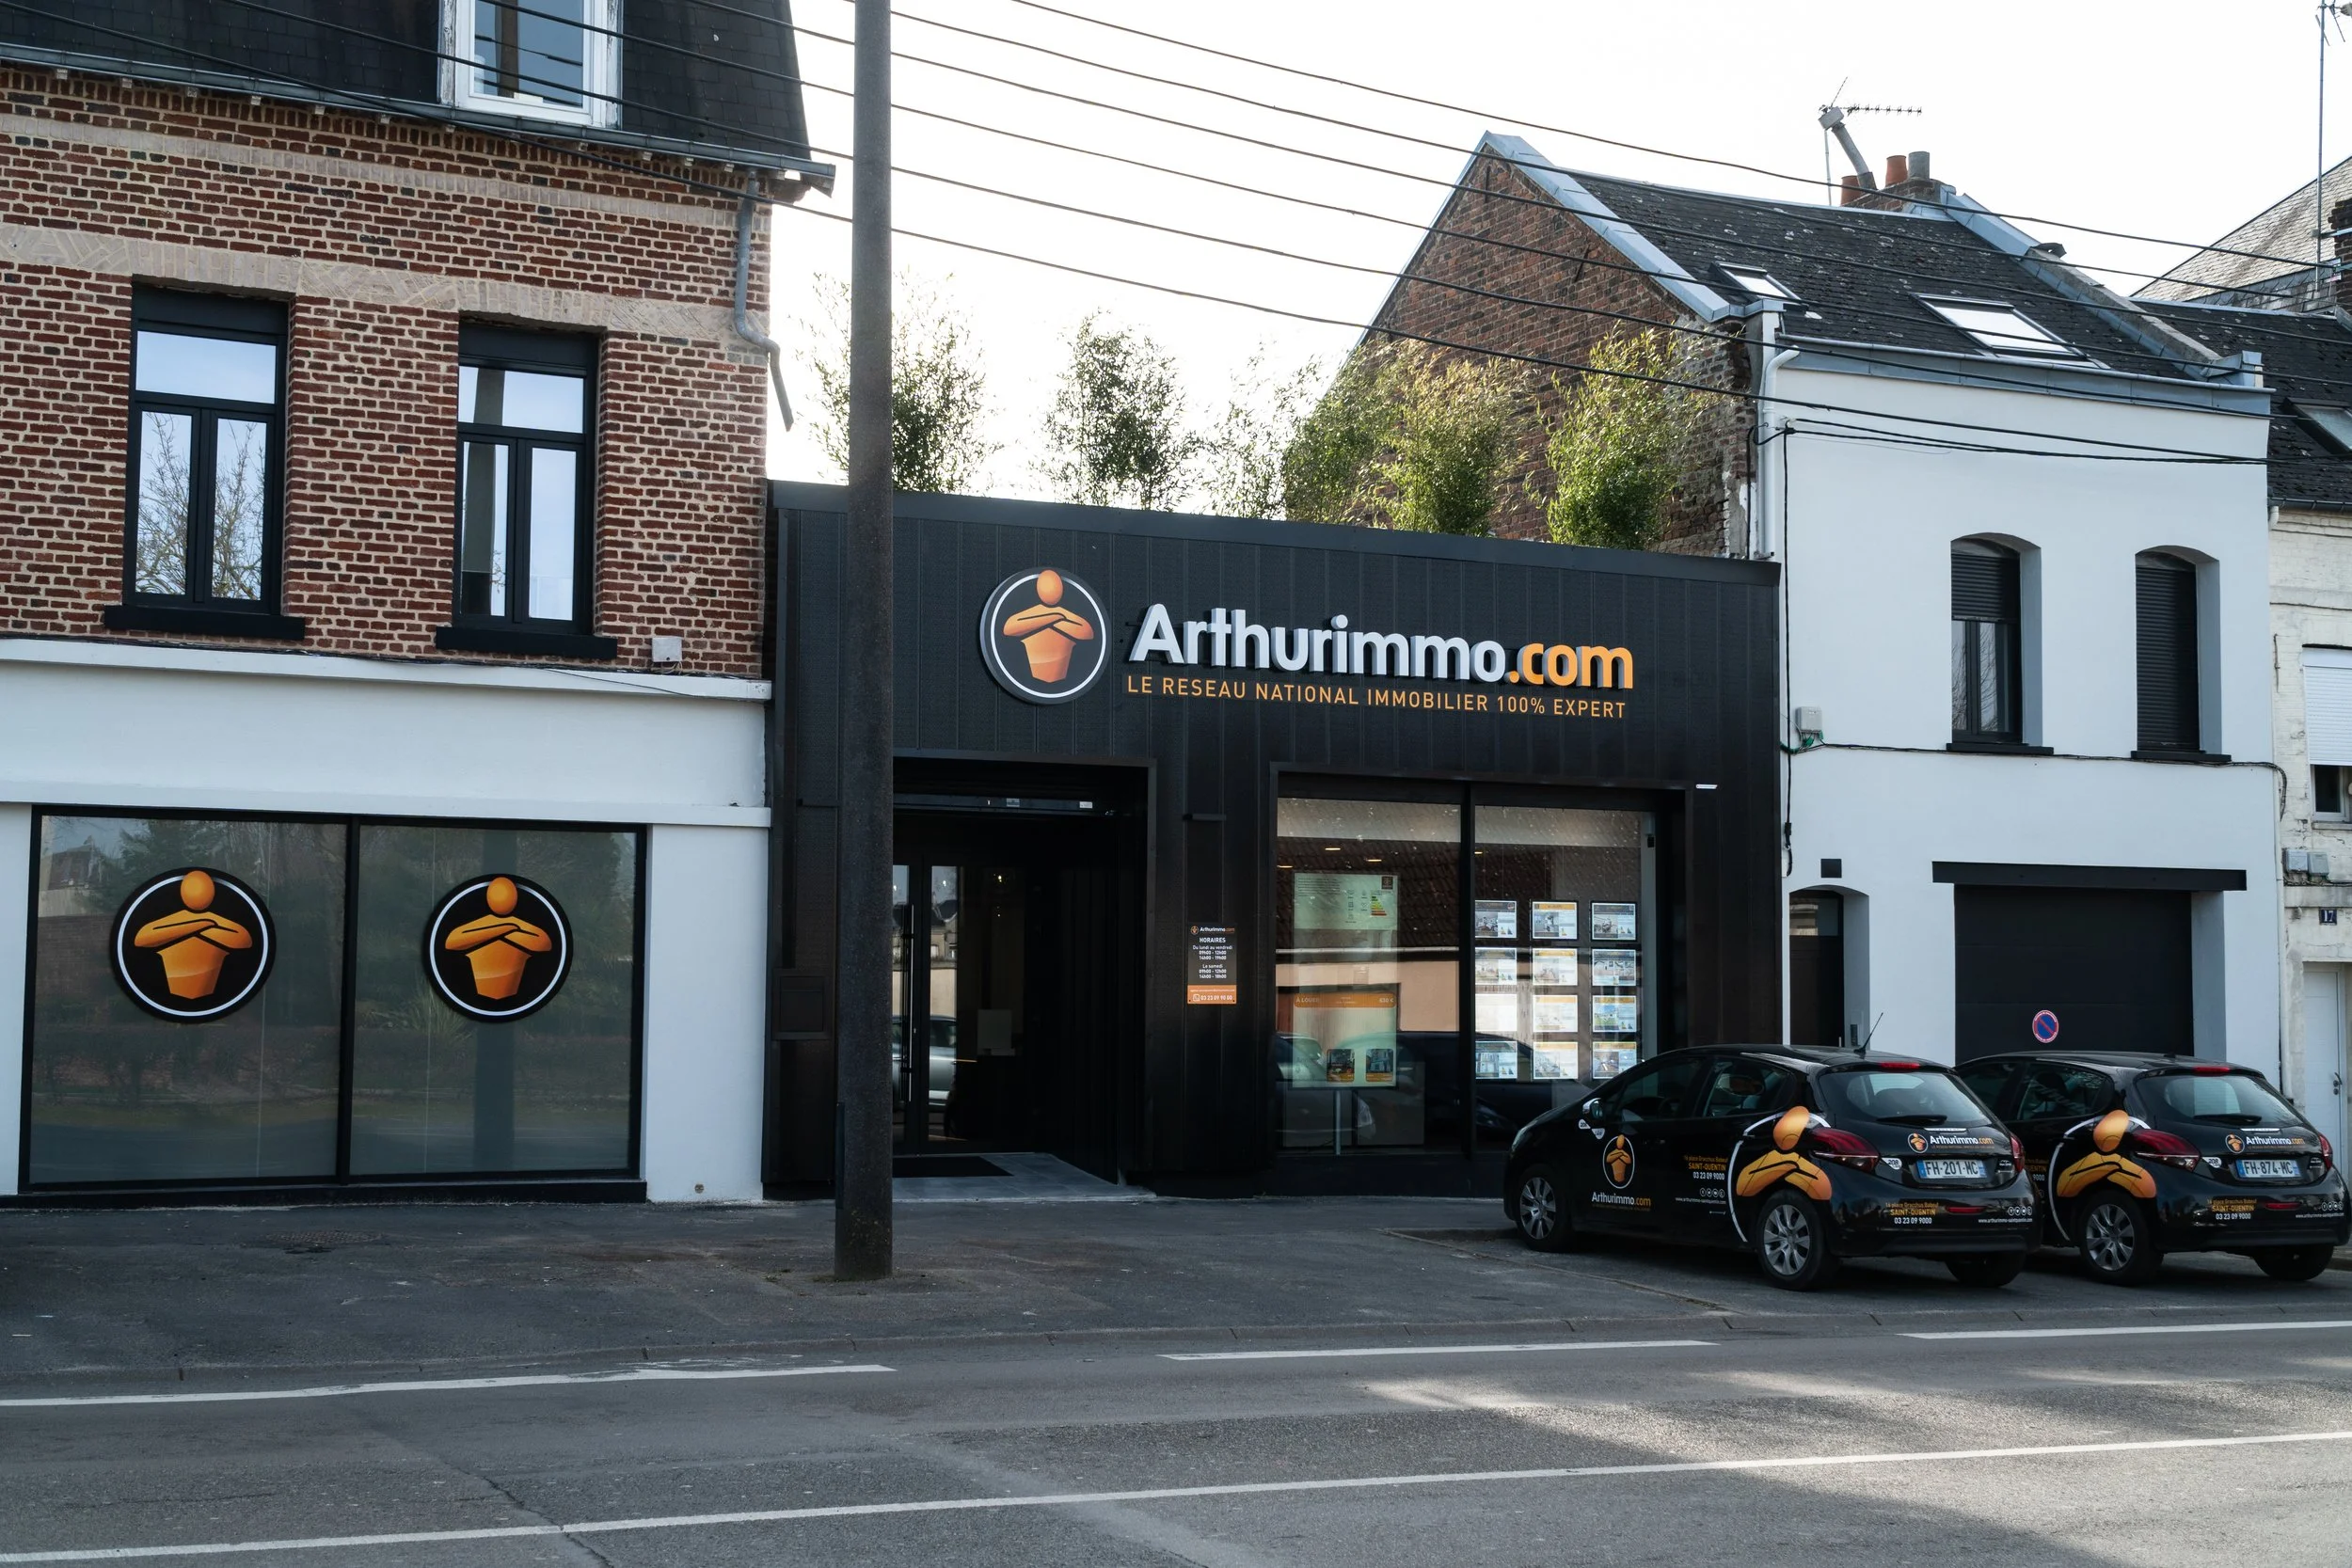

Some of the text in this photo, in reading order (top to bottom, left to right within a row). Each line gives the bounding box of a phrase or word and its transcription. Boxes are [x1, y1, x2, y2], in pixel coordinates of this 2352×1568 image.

[1128, 603, 1634, 689] Arthurimmo.com
[1128, 675, 1626, 719] LE RESEAU NATIONAL IMMOBILIER 100% EXPERT
[2324, 910, 2334, 922] 17
[1930, 1135, 1994, 1145] Arthurimmo.com
[2246, 1136, 2306, 1145] Arthurimmo.com
[2244, 1161, 2294, 1175] FH-874-MC
[1692, 1171, 1699, 1180] 03
[1699, 1171, 1706, 1180] 23
[1591, 1191, 1651, 1207] Arthurimmo.com
